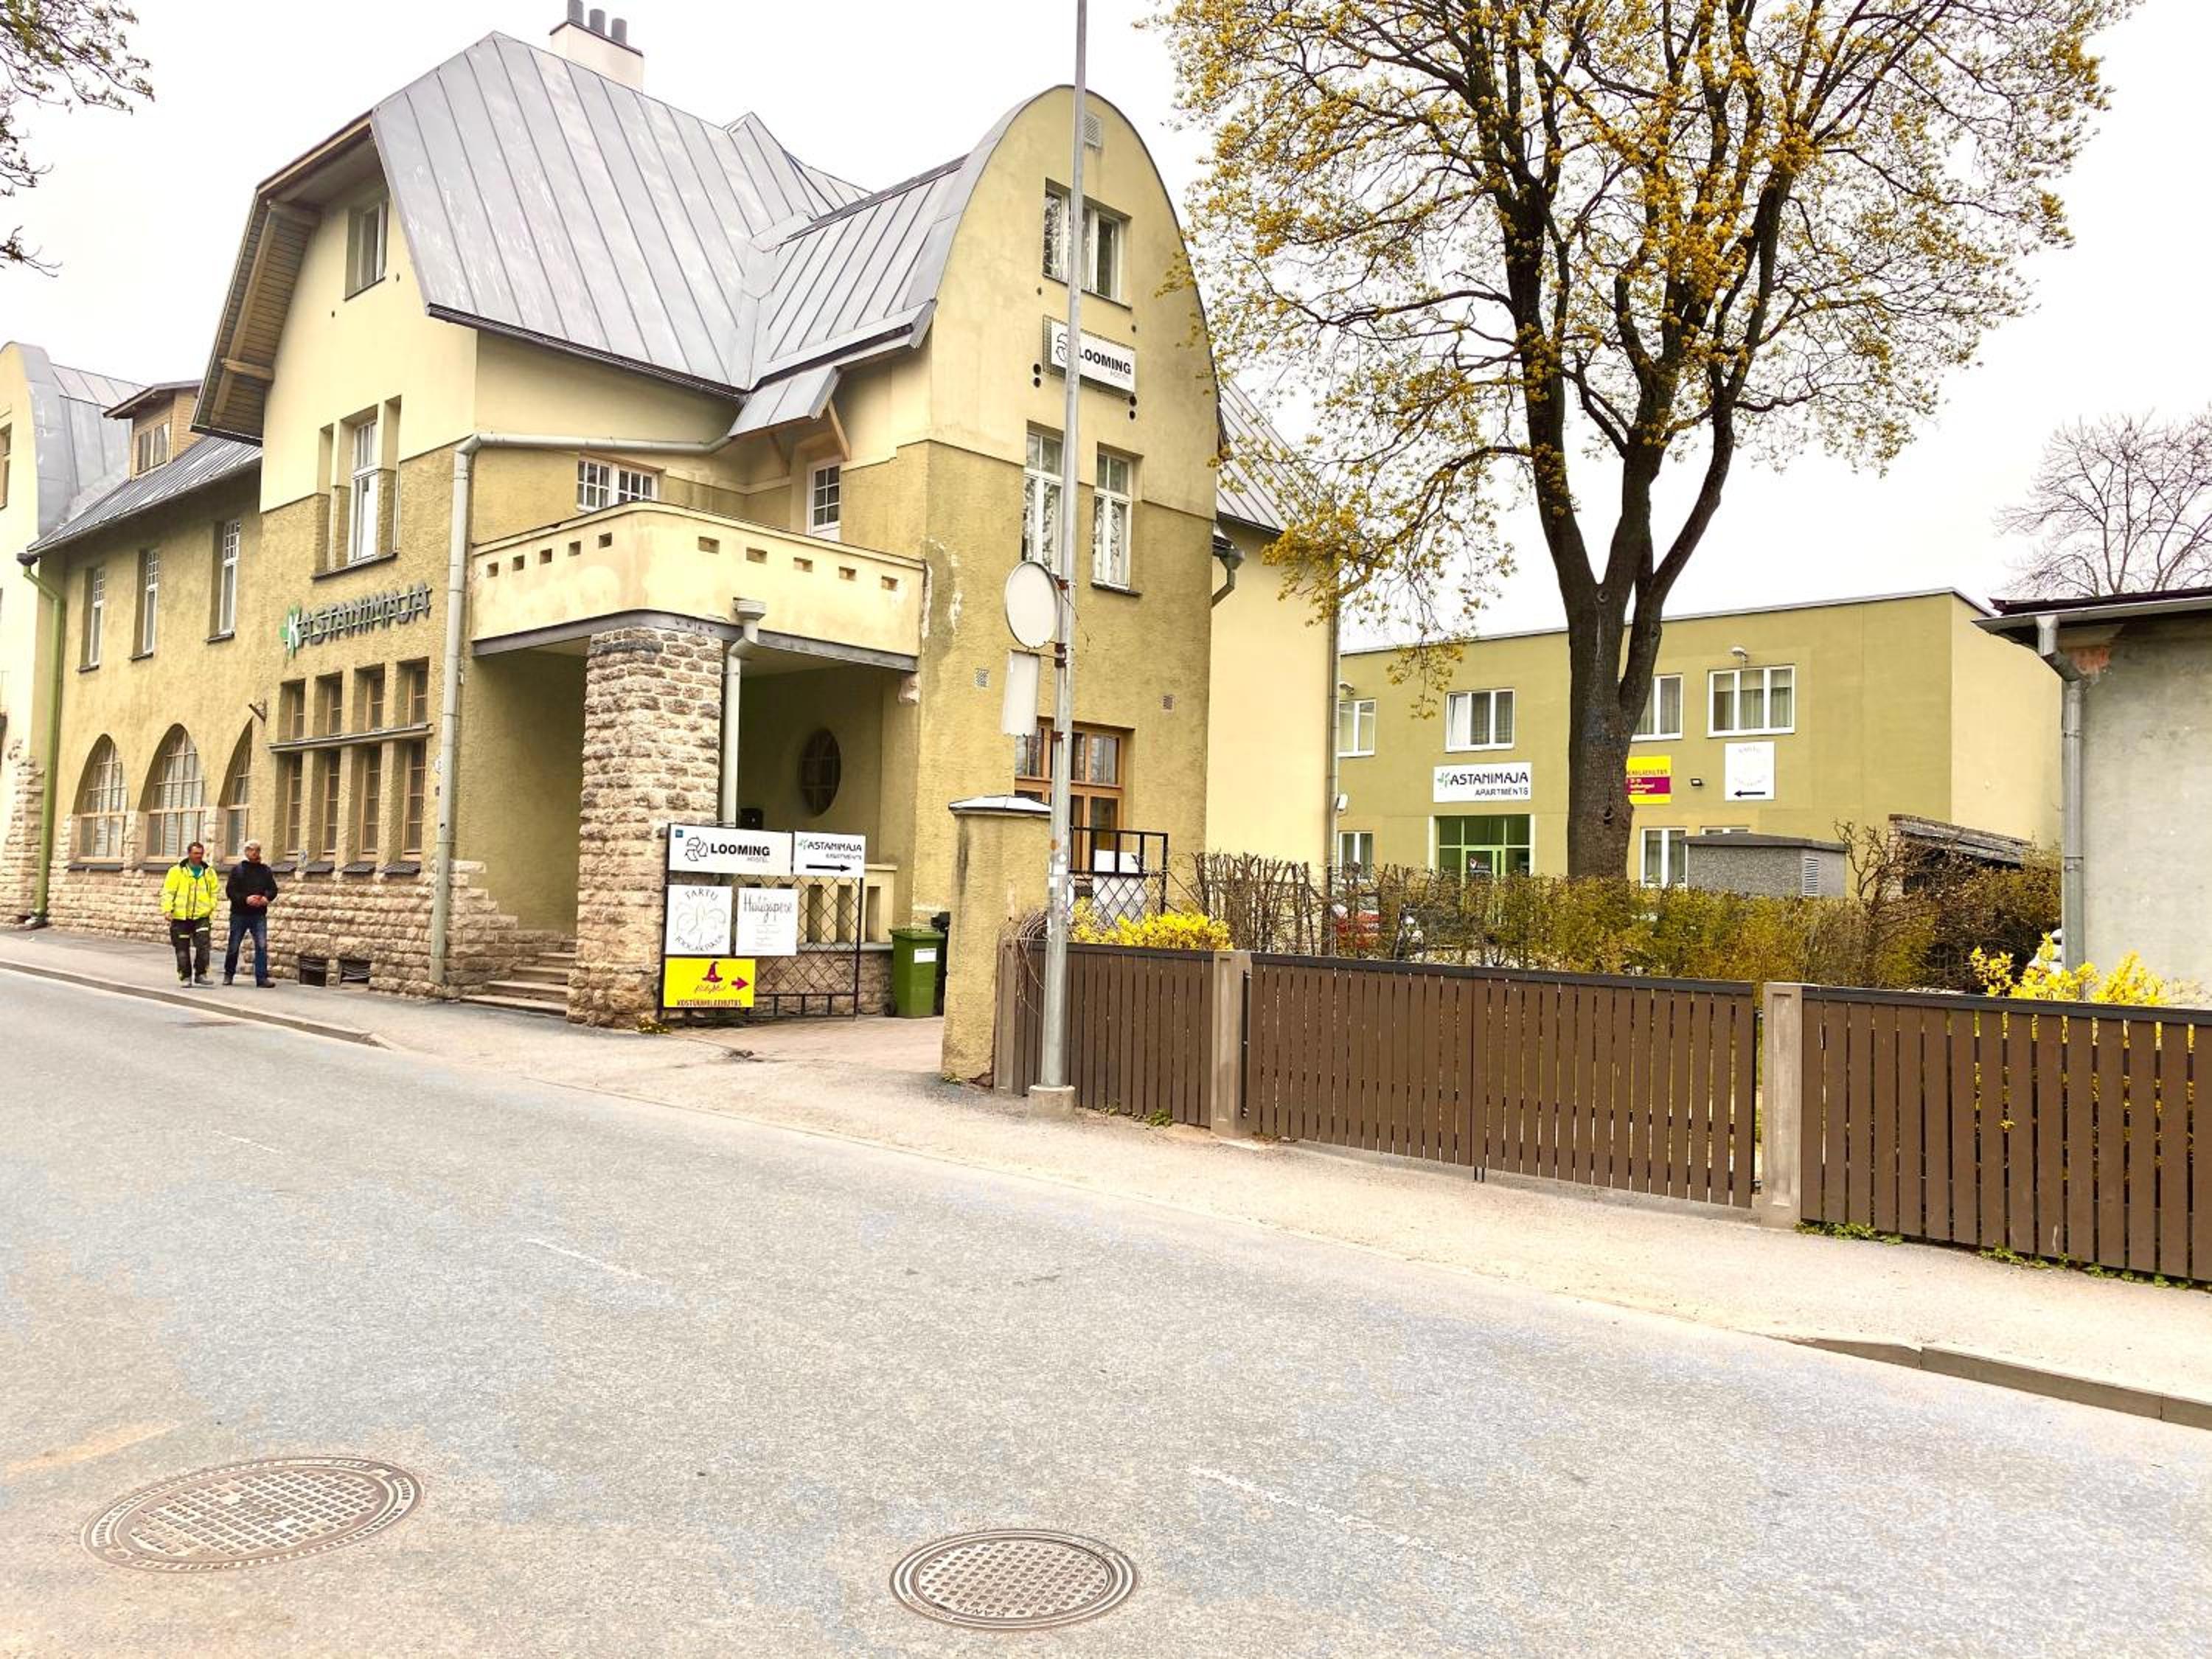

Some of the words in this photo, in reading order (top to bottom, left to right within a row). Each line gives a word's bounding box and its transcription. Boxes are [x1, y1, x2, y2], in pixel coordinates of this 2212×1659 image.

[1079, 345, 1132, 375] LOOMING
[1475, 787, 1528, 796] APARTMENTS
[710, 843, 771, 856] LOOMING
[684, 887, 720, 900] TARTU
